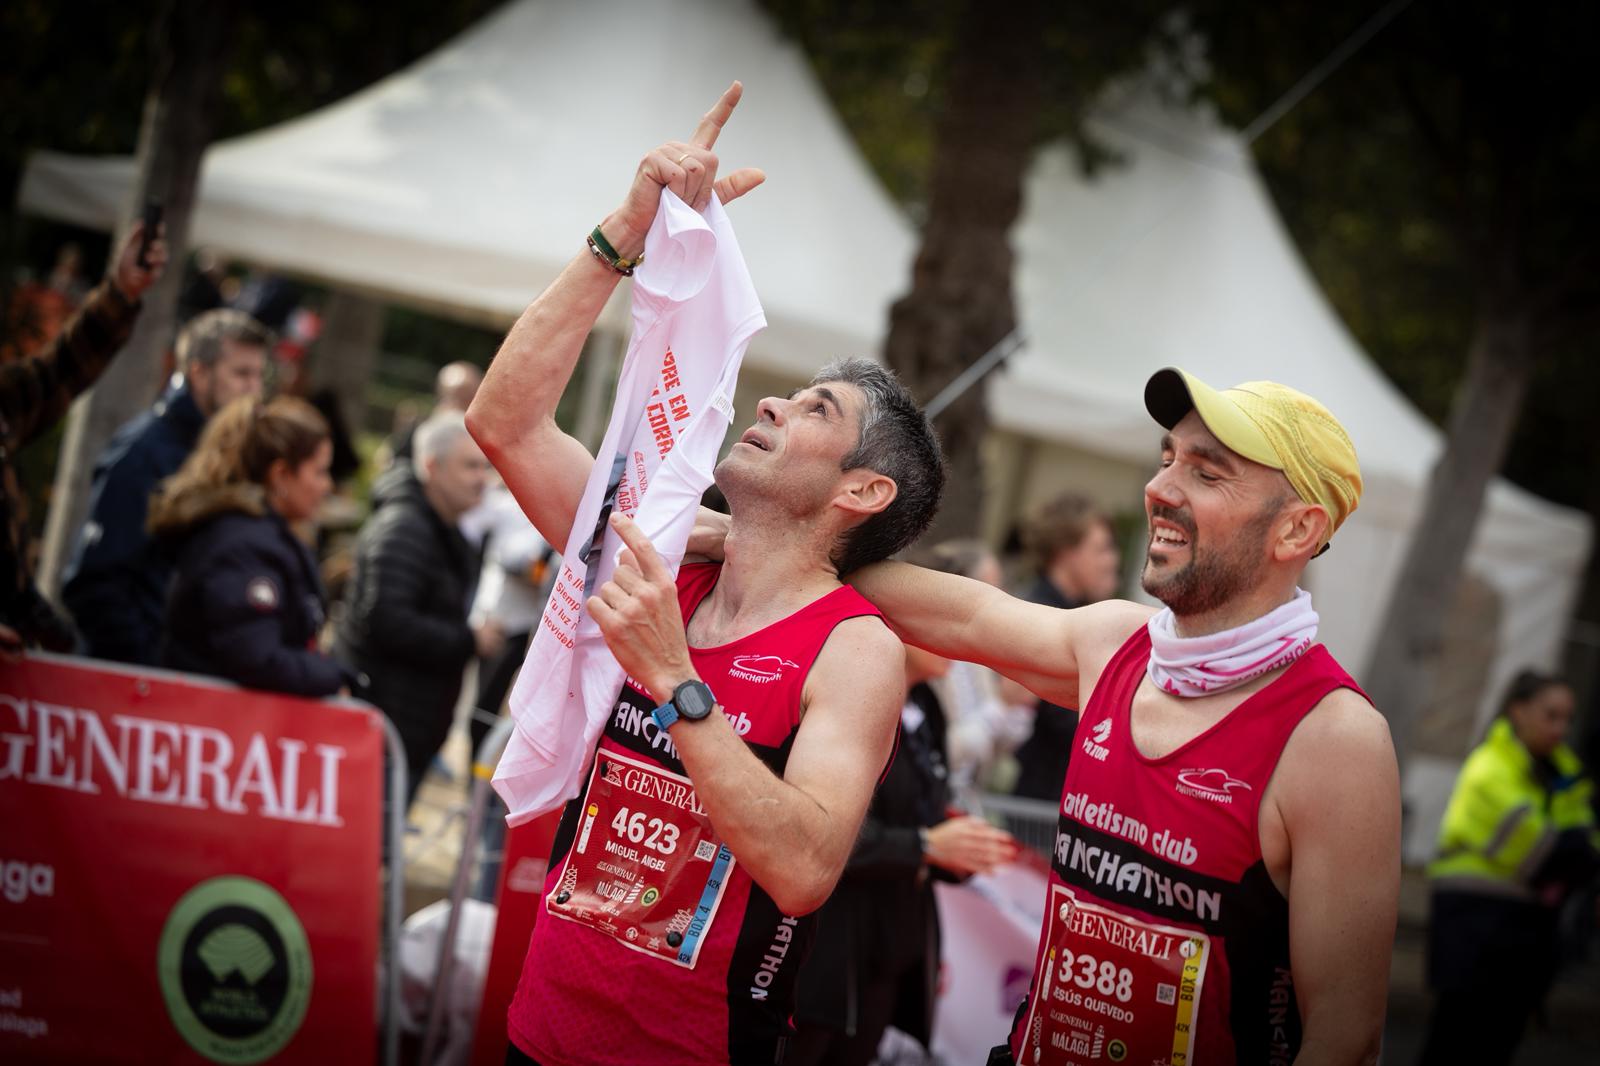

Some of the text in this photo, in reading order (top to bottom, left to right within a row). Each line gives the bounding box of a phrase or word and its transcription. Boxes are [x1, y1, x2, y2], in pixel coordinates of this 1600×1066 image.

[668, 394, 691, 422] EN
[646, 402, 675, 461] CORA
[563, 566, 573, 582] Te
[556, 582, 581, 611] Siemp
[558, 608, 572, 626] luz
[611, 806, 681, 855] 4623
[1063, 792, 1198, 866] atletismo club
[605, 840, 666, 872] MIGUEL ANGEL
[0, 861, 55, 903] ga
[707, 879, 721, 890] 42K
[1054, 825, 1222, 921] ANCHATHON
[688, 904, 711, 939] BOX 4
[1068, 910, 1175, 960] GENERALI
[1058, 947, 1134, 1003] 3388
[1180, 964, 1199, 1002] BOX 3
[1084, 996, 1135, 1024] QUEVEDO
[1051, 1031, 1091, 1057] MÁLAGA
[1175, 1022, 1190, 1033] 42K
